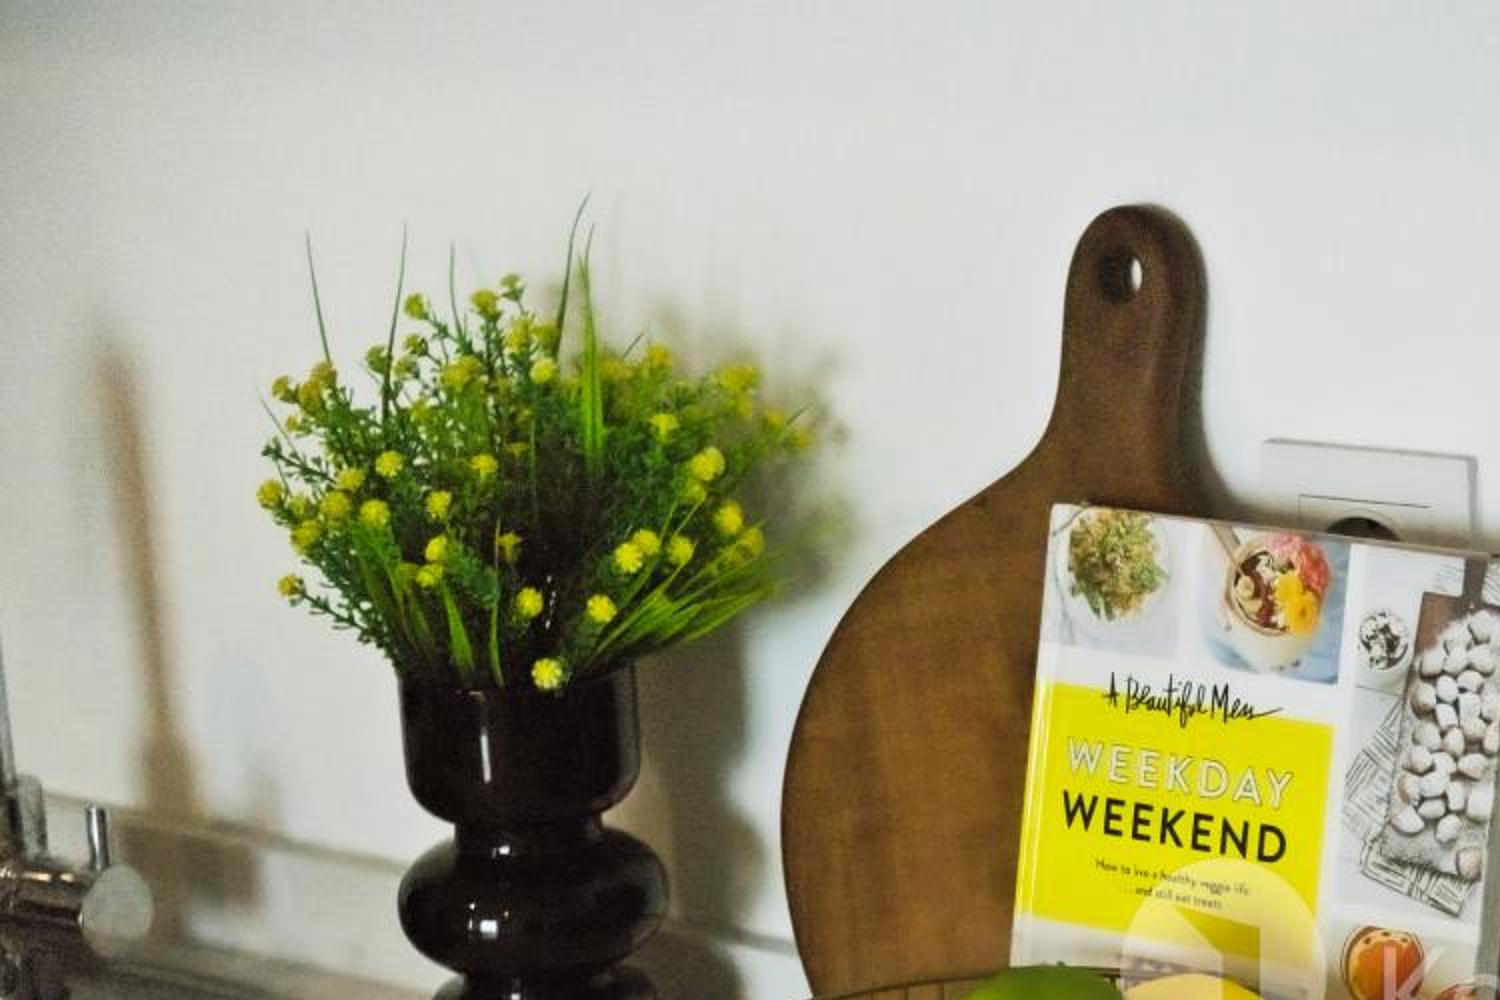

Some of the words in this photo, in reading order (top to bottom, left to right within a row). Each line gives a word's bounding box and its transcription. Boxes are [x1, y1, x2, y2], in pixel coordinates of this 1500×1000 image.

[1102, 671, 1120, 708] A
[1124, 673, 1208, 729] Beautiful
[1211, 682, 1284, 725] Mess
[1067, 736, 1294, 809] WEEKDAY
[1062, 788, 1287, 863] WEEKEND
[1095, 857, 1118, 872] How
